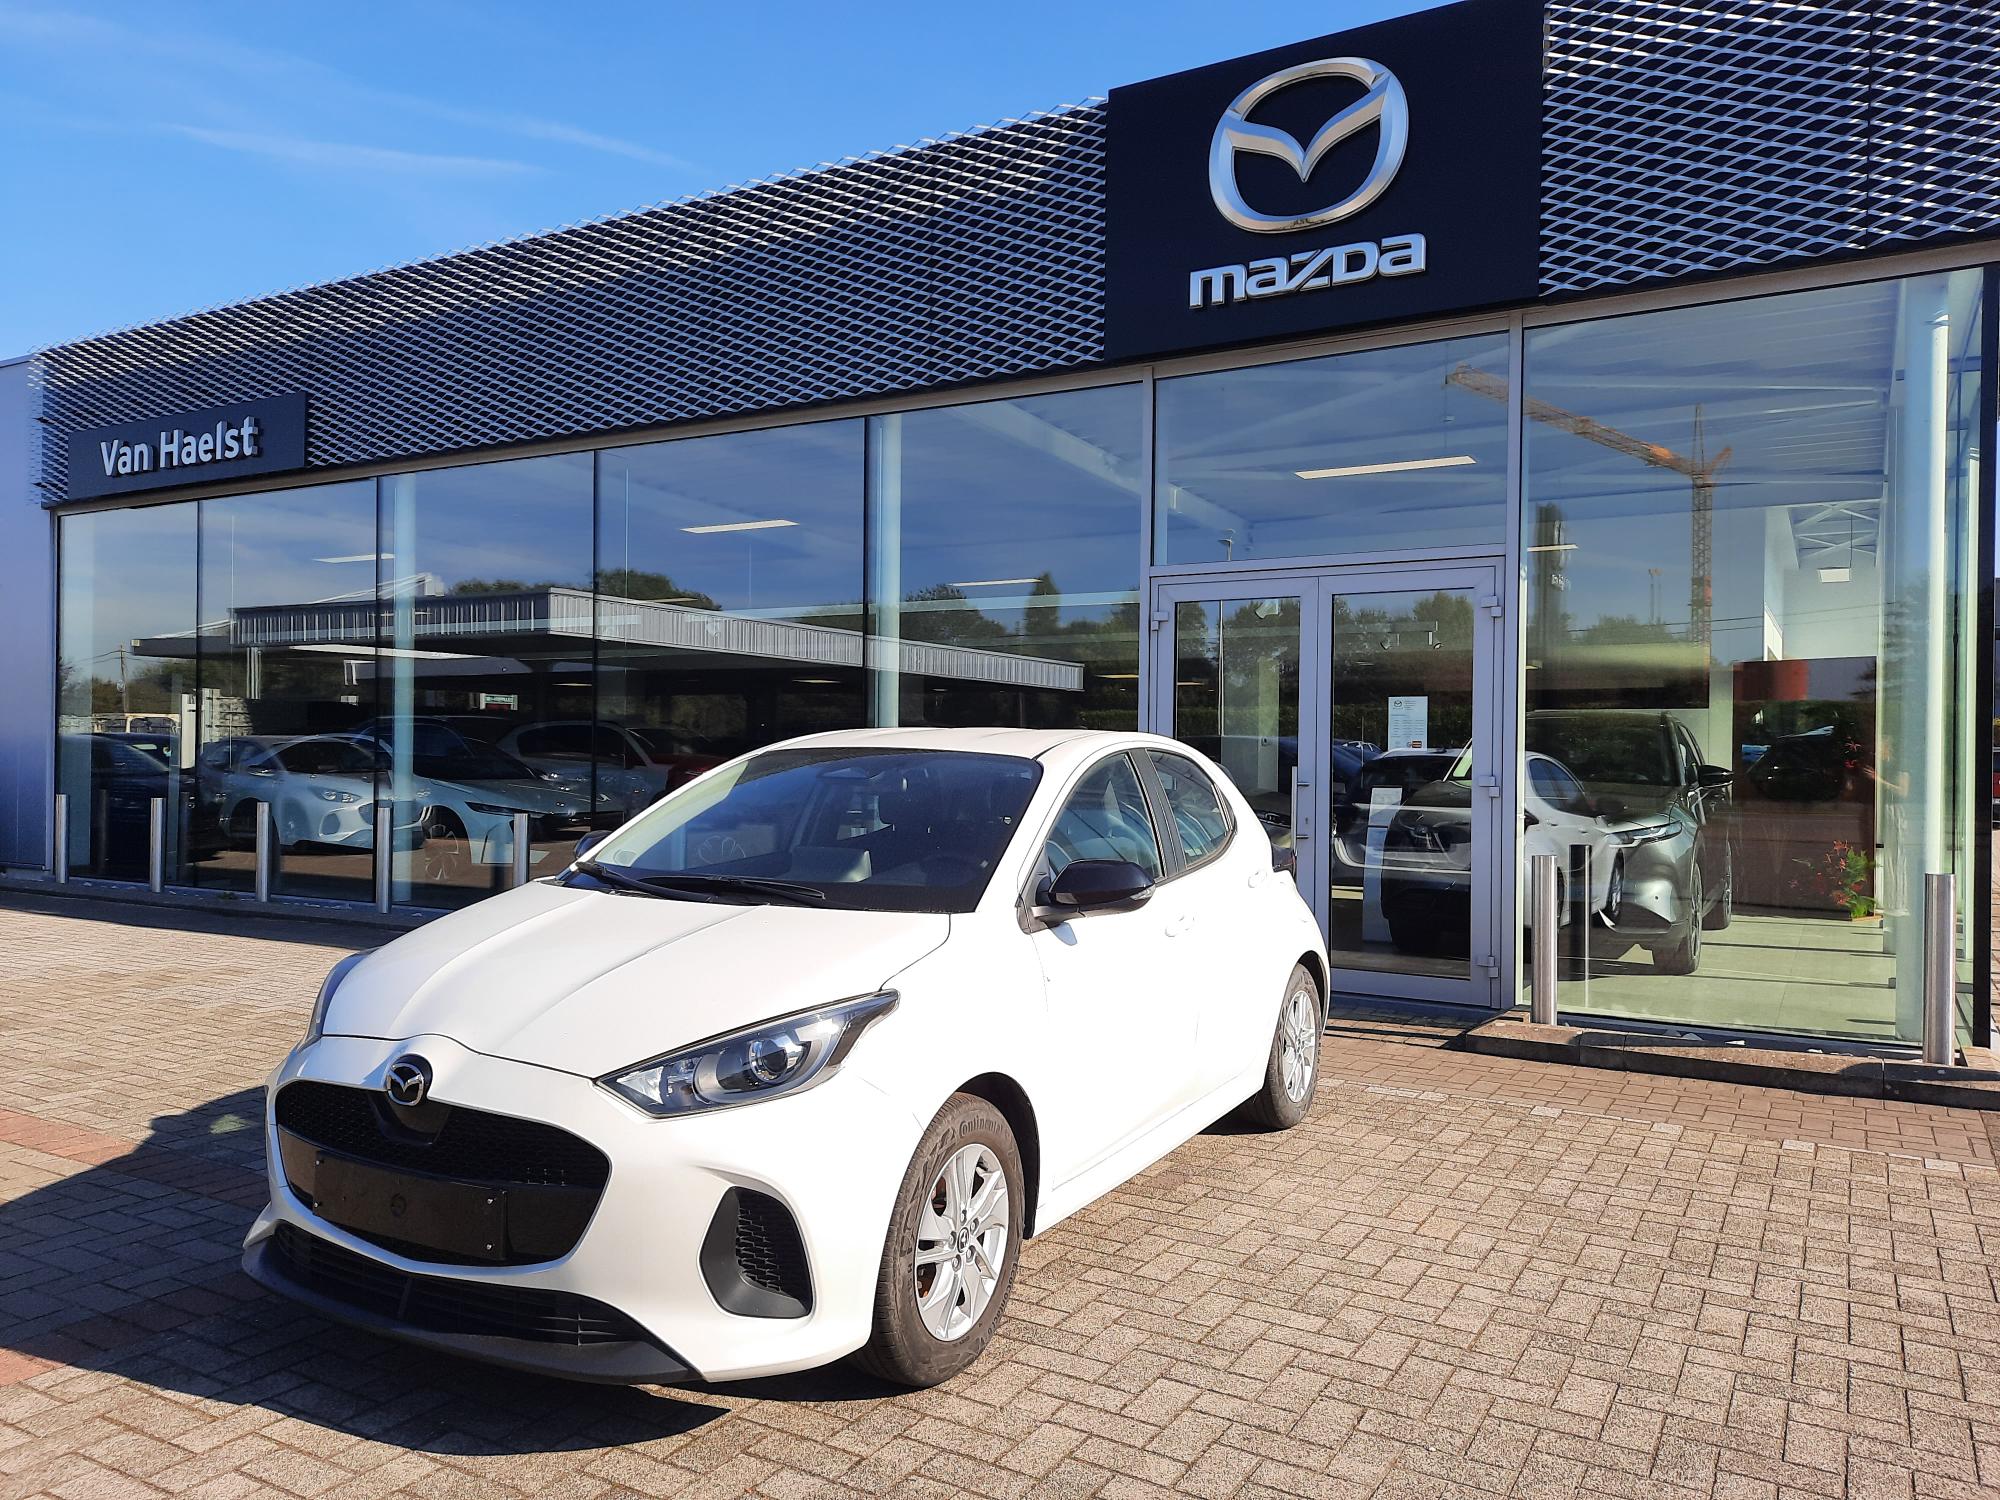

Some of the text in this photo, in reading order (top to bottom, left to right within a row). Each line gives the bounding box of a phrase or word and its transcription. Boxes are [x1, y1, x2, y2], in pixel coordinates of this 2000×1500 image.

[101, 416, 258, 476] Van Haelst
[959, 1115, 1003, 1138] Continental
